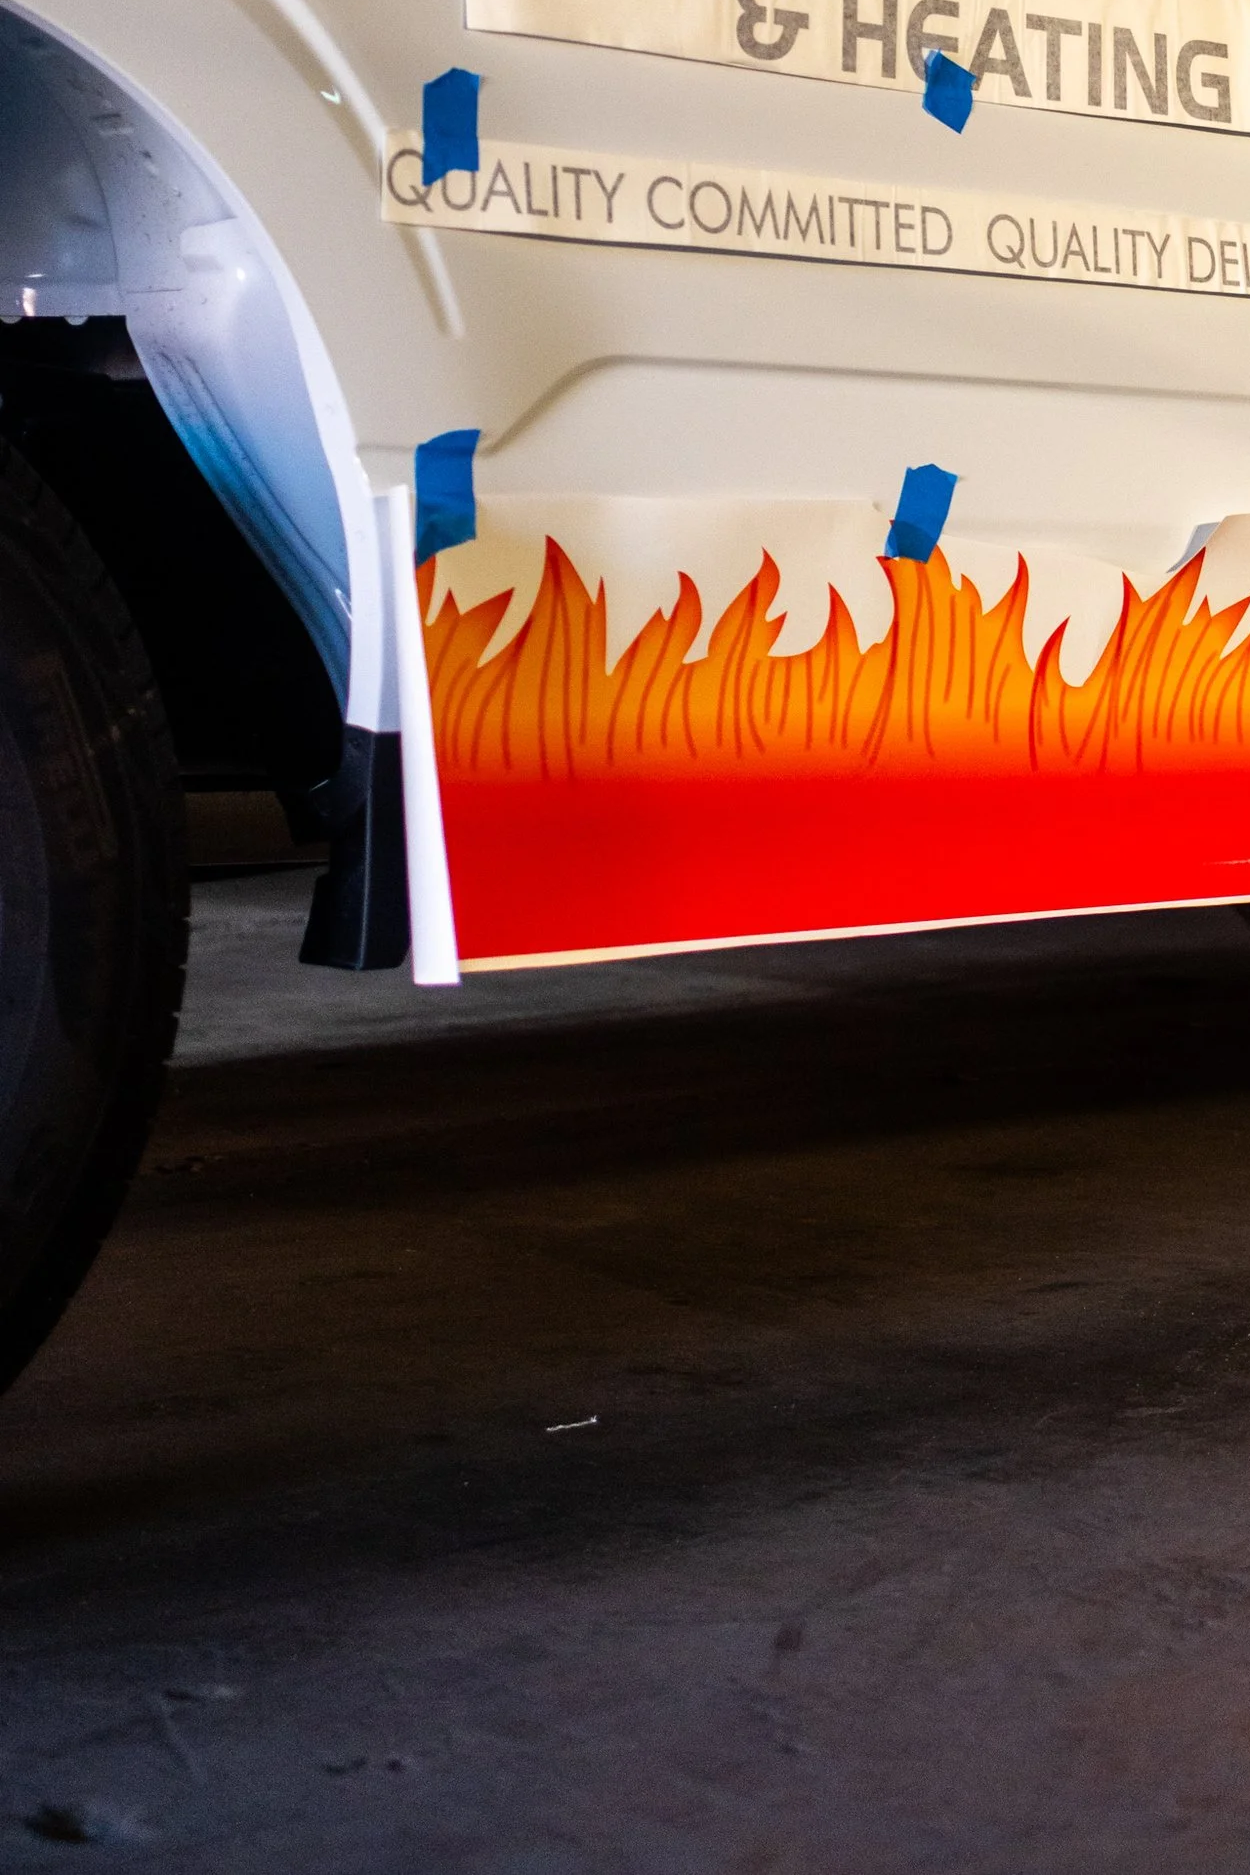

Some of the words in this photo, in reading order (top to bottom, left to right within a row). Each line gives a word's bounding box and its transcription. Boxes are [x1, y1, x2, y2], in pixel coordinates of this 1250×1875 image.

[387, 148, 624, 223] QUALITY
[647, 176, 952, 255] COMMITTED
[987, 213, 1170, 277] QUALITY
